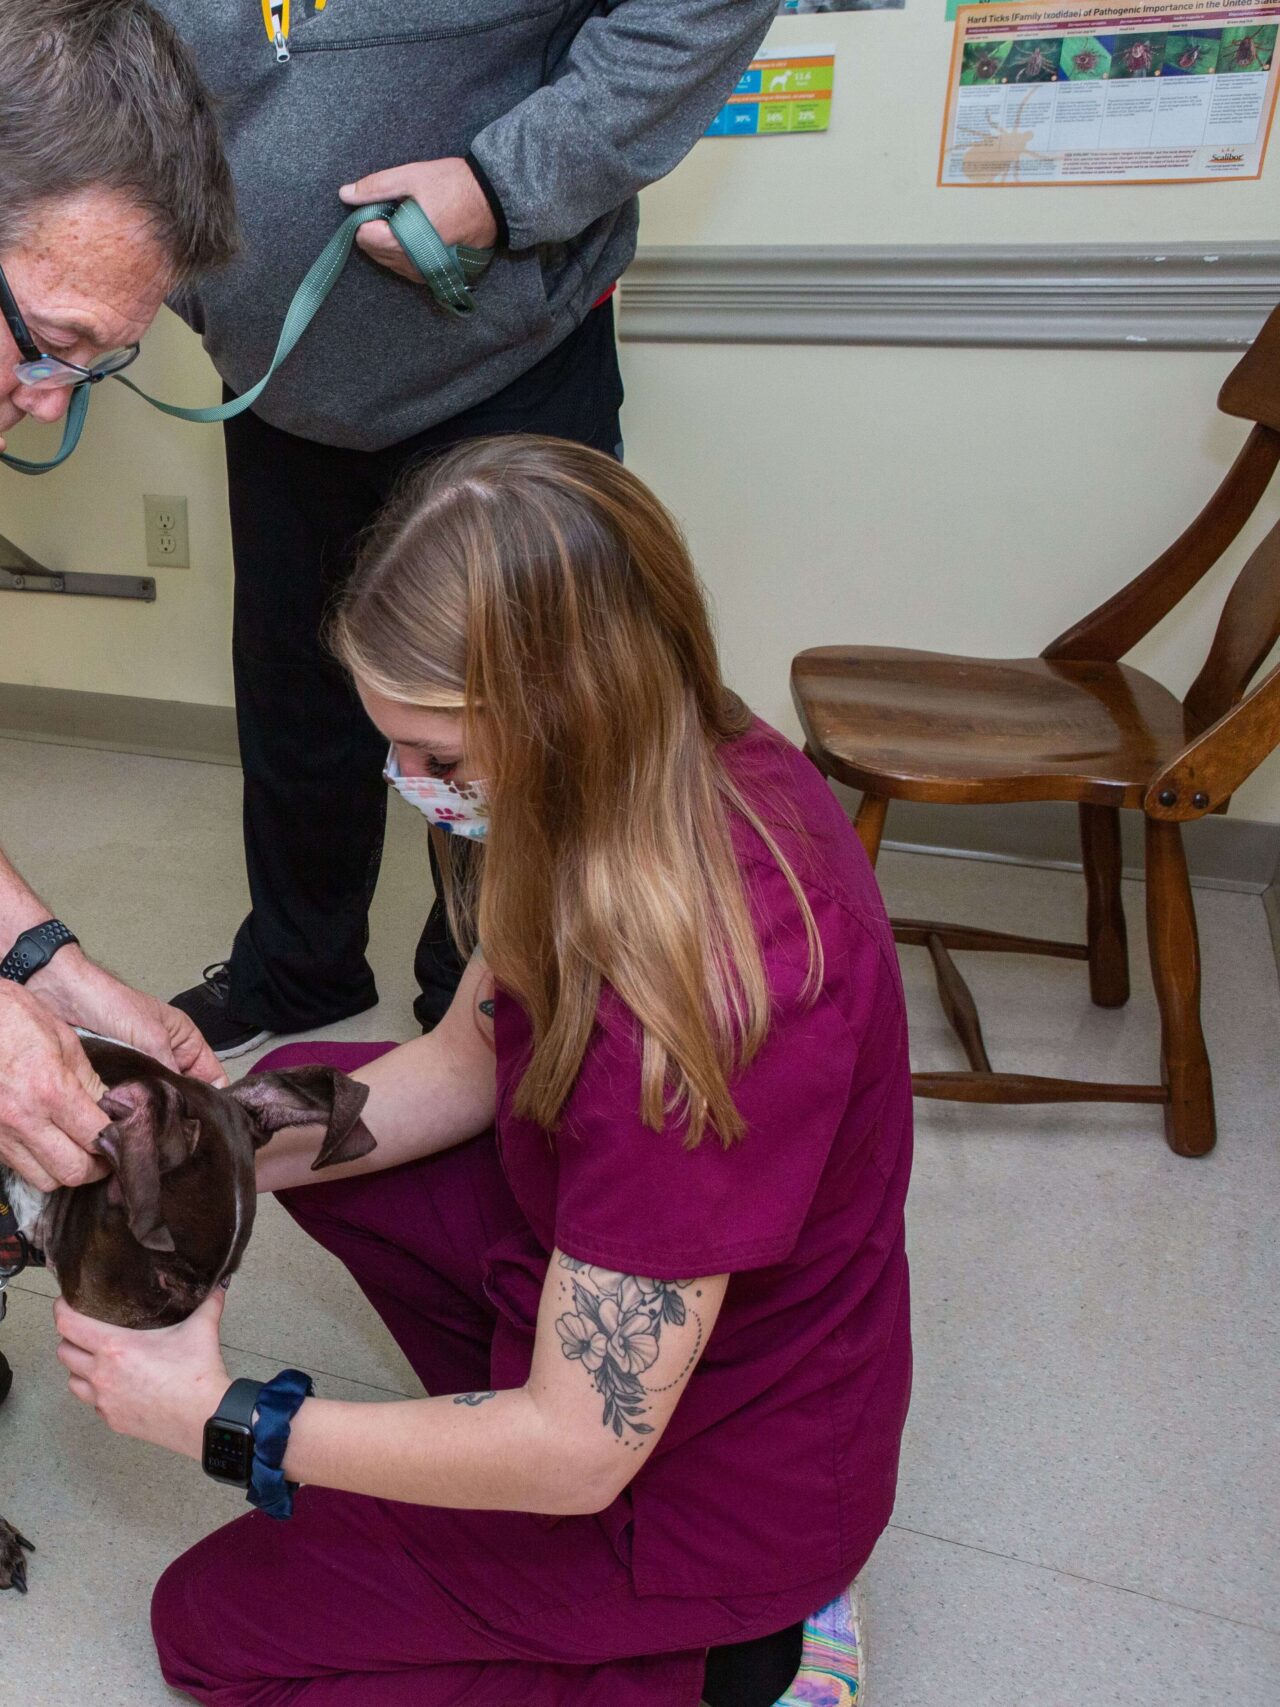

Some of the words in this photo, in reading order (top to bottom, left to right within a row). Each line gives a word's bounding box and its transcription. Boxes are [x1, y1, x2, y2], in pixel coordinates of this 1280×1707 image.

[967, 15, 987, 24] Hard
[990, 14, 1010, 23] Ticks
[1083, 8, 1092, 17] of
[1093, 6, 1141, 16] Pathogenic
[1143, 3, 1193, 14] Importance
[1206, 0, 1220, 8] the
